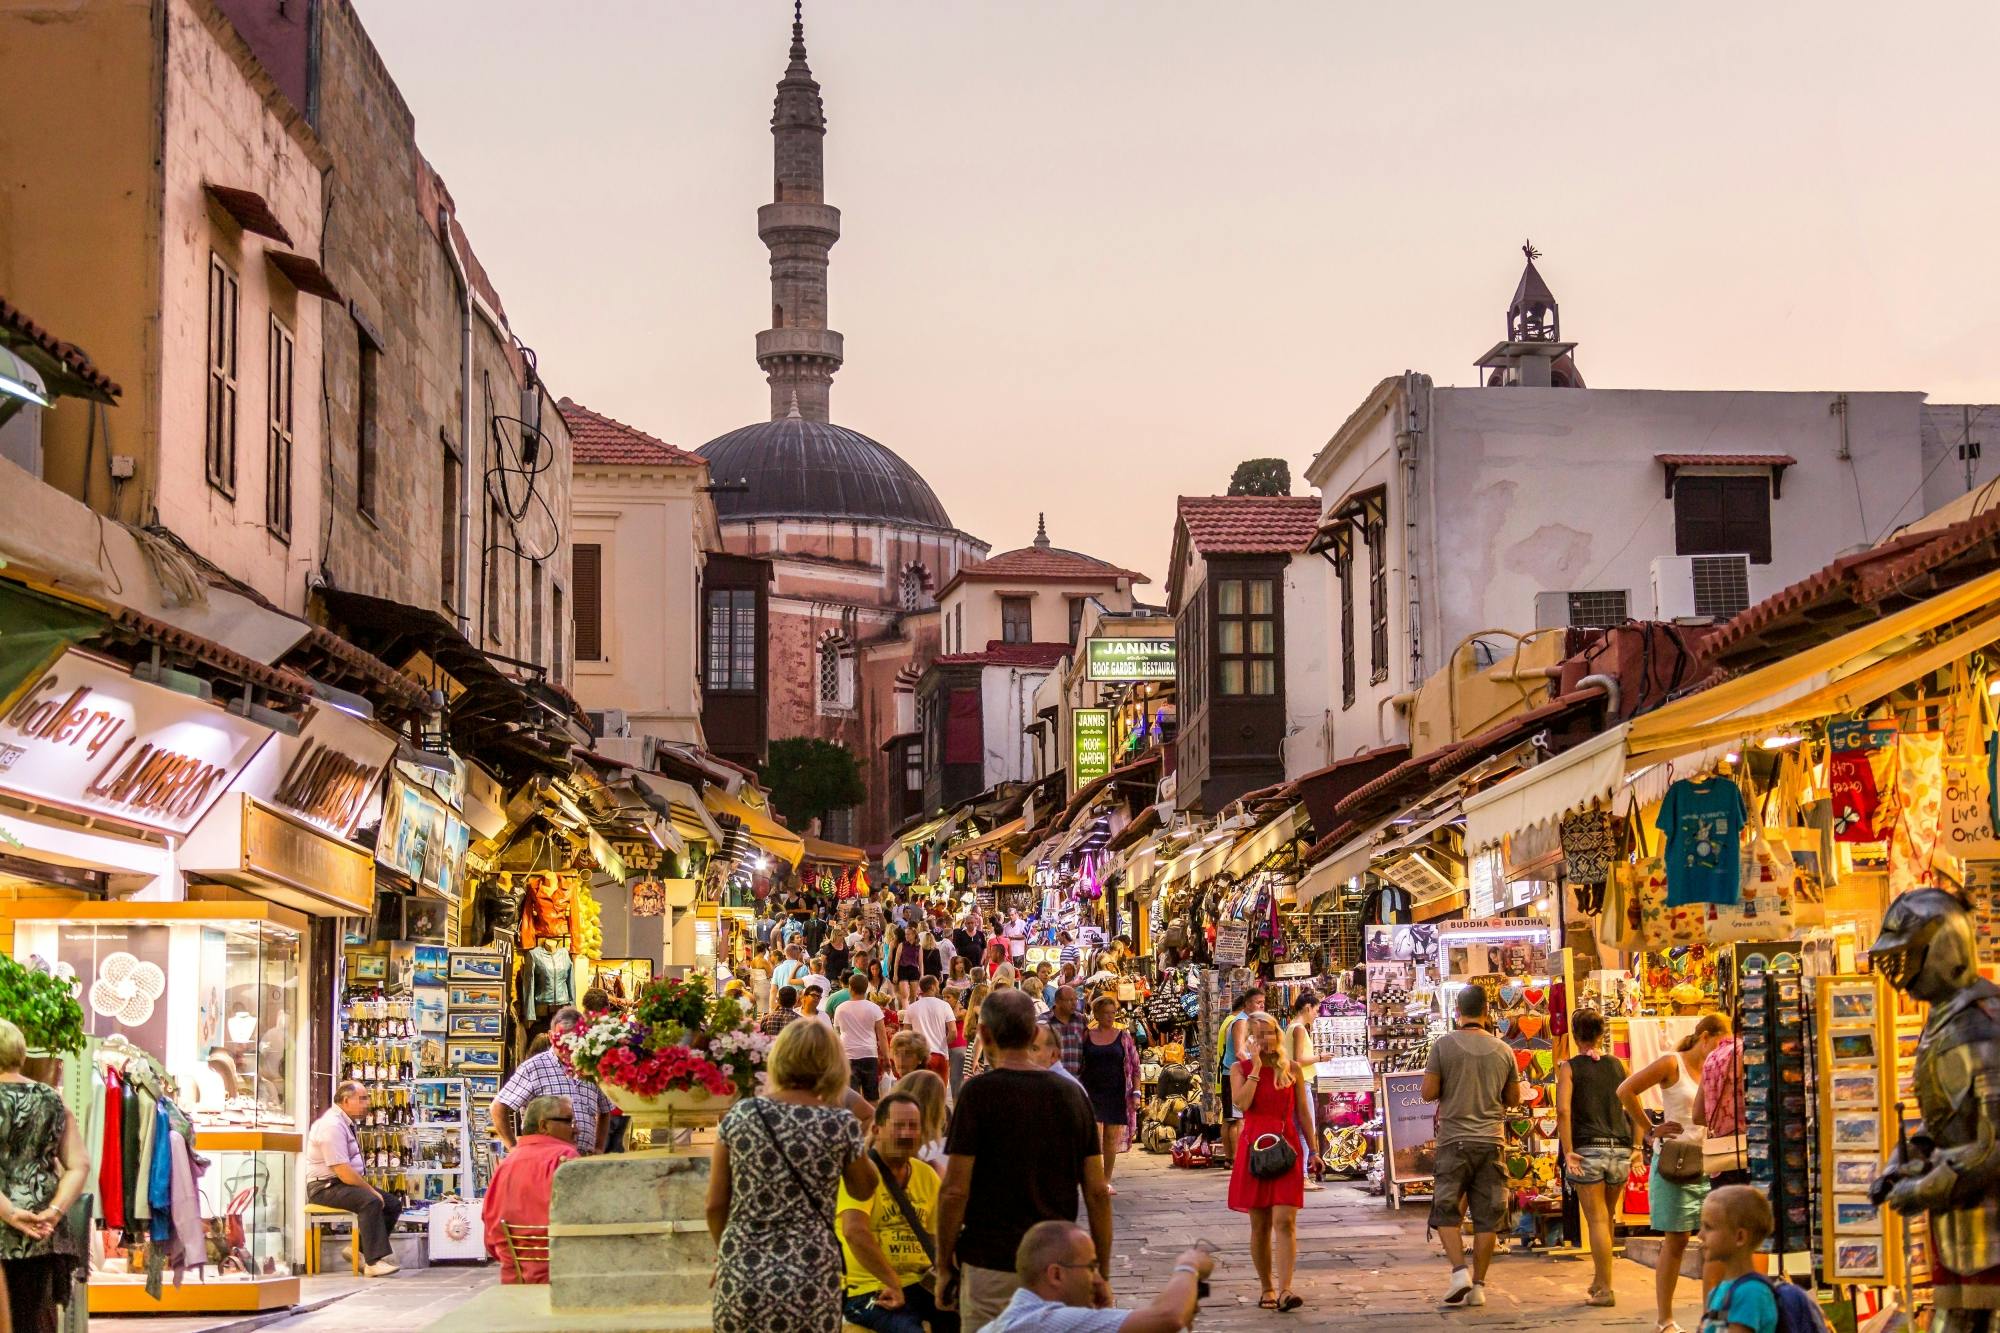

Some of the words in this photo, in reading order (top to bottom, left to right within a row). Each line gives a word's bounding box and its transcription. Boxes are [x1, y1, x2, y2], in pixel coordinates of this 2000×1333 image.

[1103, 642, 1170, 654] JANNIS
[1092, 661, 1110, 676] ROOF
[1111, 661, 1137, 676] GARDEN
[7, 675, 125, 762] Gallery
[1078, 714, 1105, 727] JANNIS
[1083, 738, 1101, 751] ROOF
[1079, 752, 1105, 765] GARDEN
[86, 736, 227, 819] LAMBROS
[1943, 764, 1967, 778] Yu
[273, 736, 379, 829] LAMBROS
[1951, 804, 1978, 824] Live
[1951, 825, 1990, 844] Once
[625, 856, 663, 870] ARS
[1450, 920, 1489, 929] BUDDHA
[1504, 918, 1543, 927] BUDDHA
[1473, 977, 1496, 985] HAND
[1323, 1104, 1369, 1113] TRESURE
